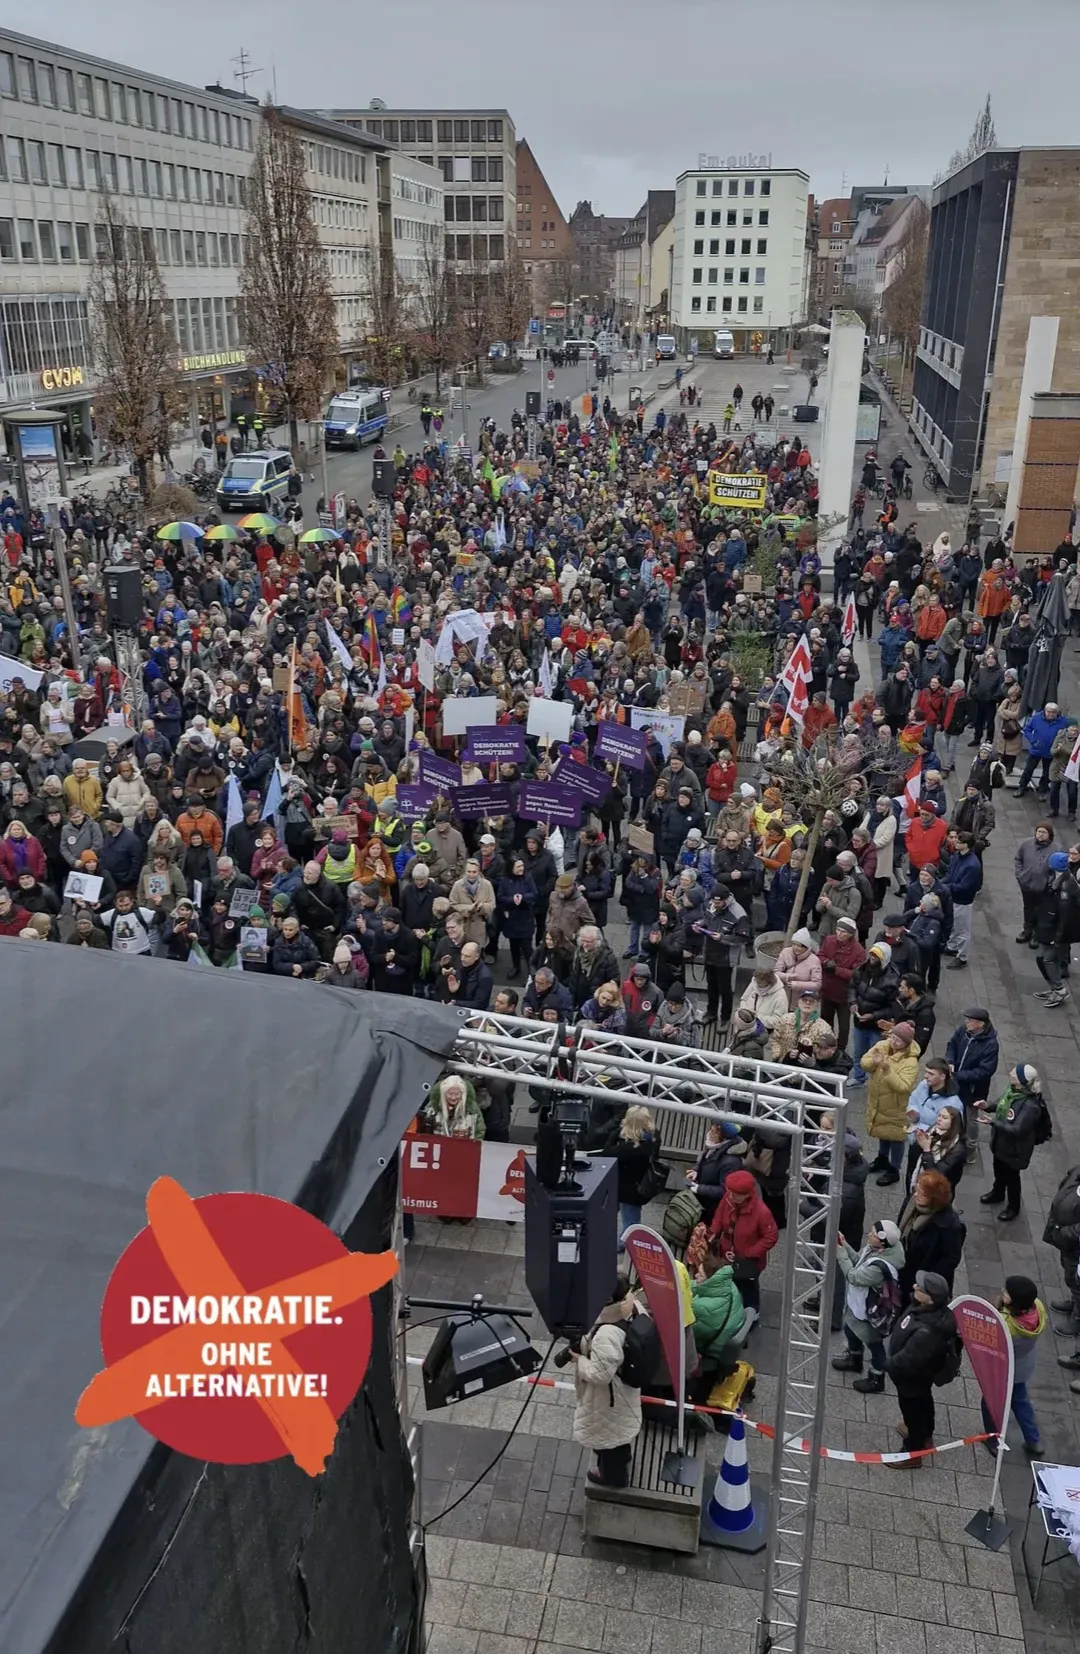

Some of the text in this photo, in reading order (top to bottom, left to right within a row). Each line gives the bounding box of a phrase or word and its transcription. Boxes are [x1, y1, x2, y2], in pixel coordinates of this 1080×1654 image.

[183, 350, 246, 371] BUCHHANDLUNG
[42, 366, 83, 389] CVJM
[715, 476, 763, 486] DEMOKRATIE
[716, 487, 759, 498] SCHÜTZEN!
[601, 736, 642, 755] DEMOKRATIE
[474, 748, 514, 756] SCHÜTZEN!
[600, 743, 635, 760] SCHÜTZEN!
[526, 794, 559, 803] Gemeinsam
[544, 803, 574, 812] Rassismus
